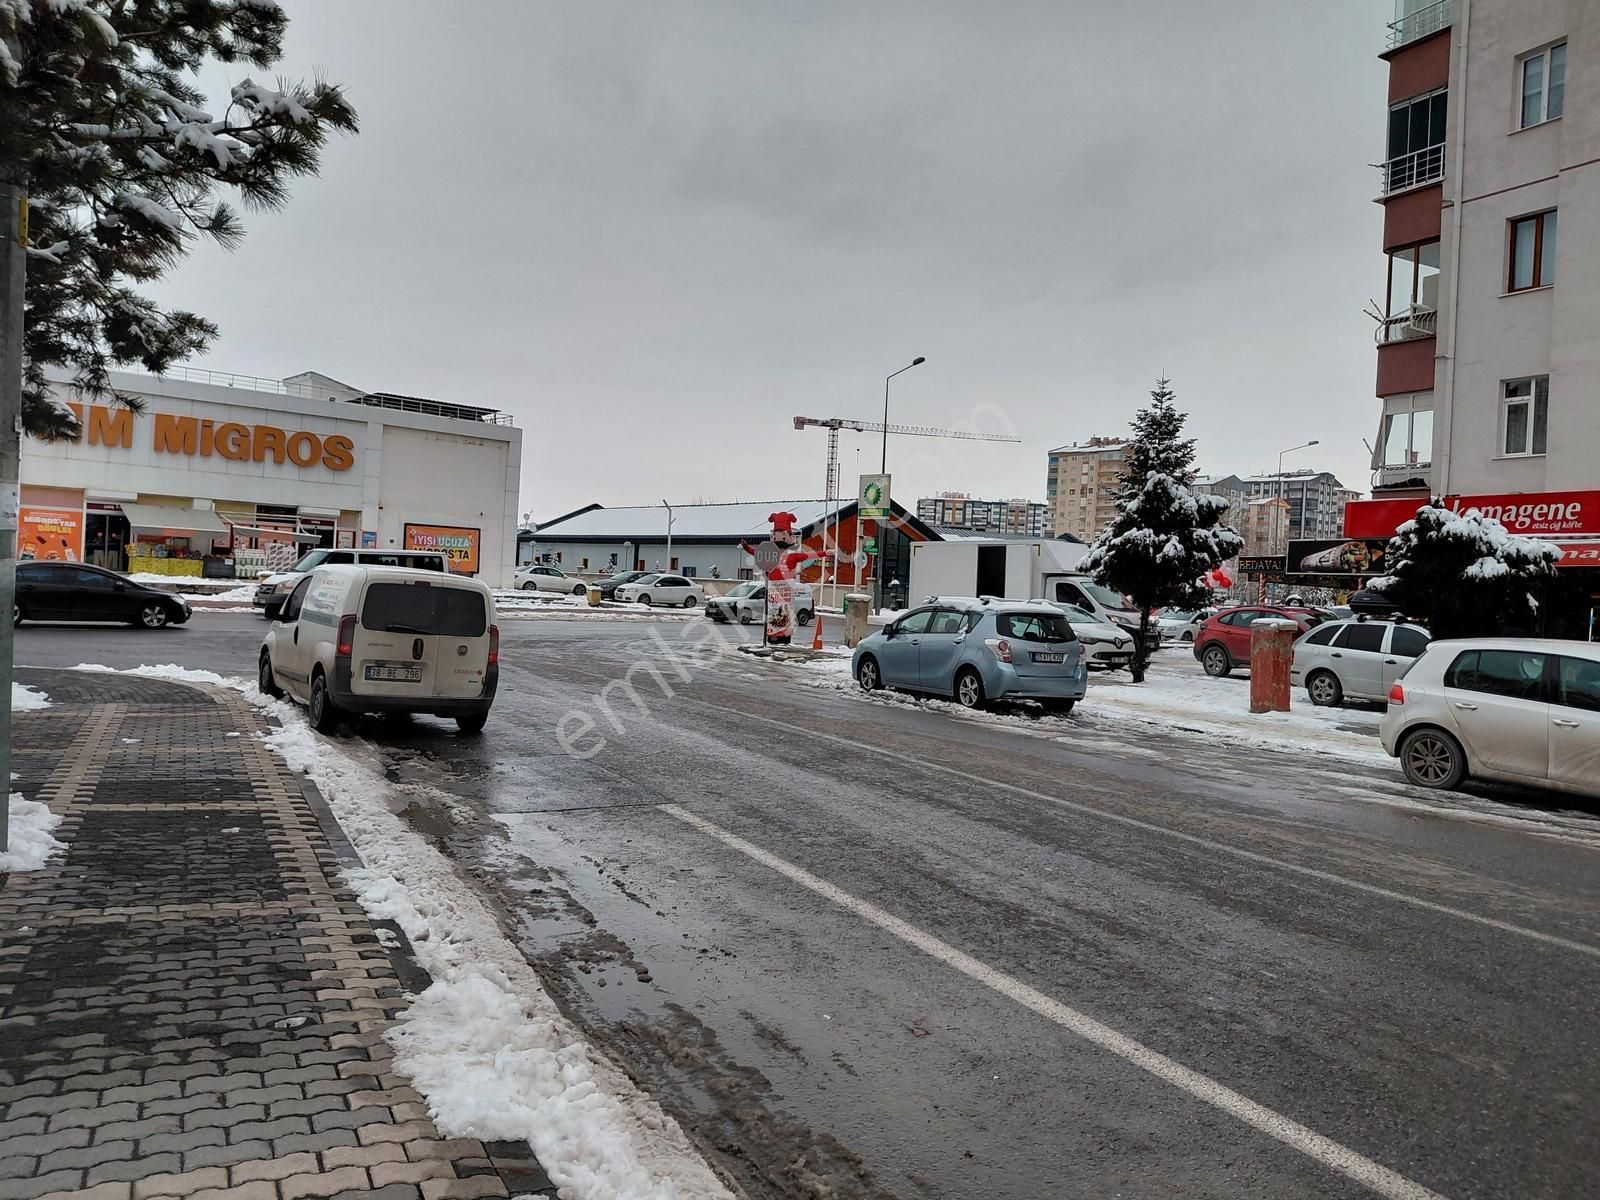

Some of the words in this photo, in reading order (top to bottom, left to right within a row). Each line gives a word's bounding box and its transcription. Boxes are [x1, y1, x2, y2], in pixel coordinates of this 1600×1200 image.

[438, 536, 470, 548] UCUZA
[757, 550, 779, 561] DUR
[370, 668, 381, 677] 38
[387, 669, 398, 678] BE
[404, 669, 420, 679] 296
